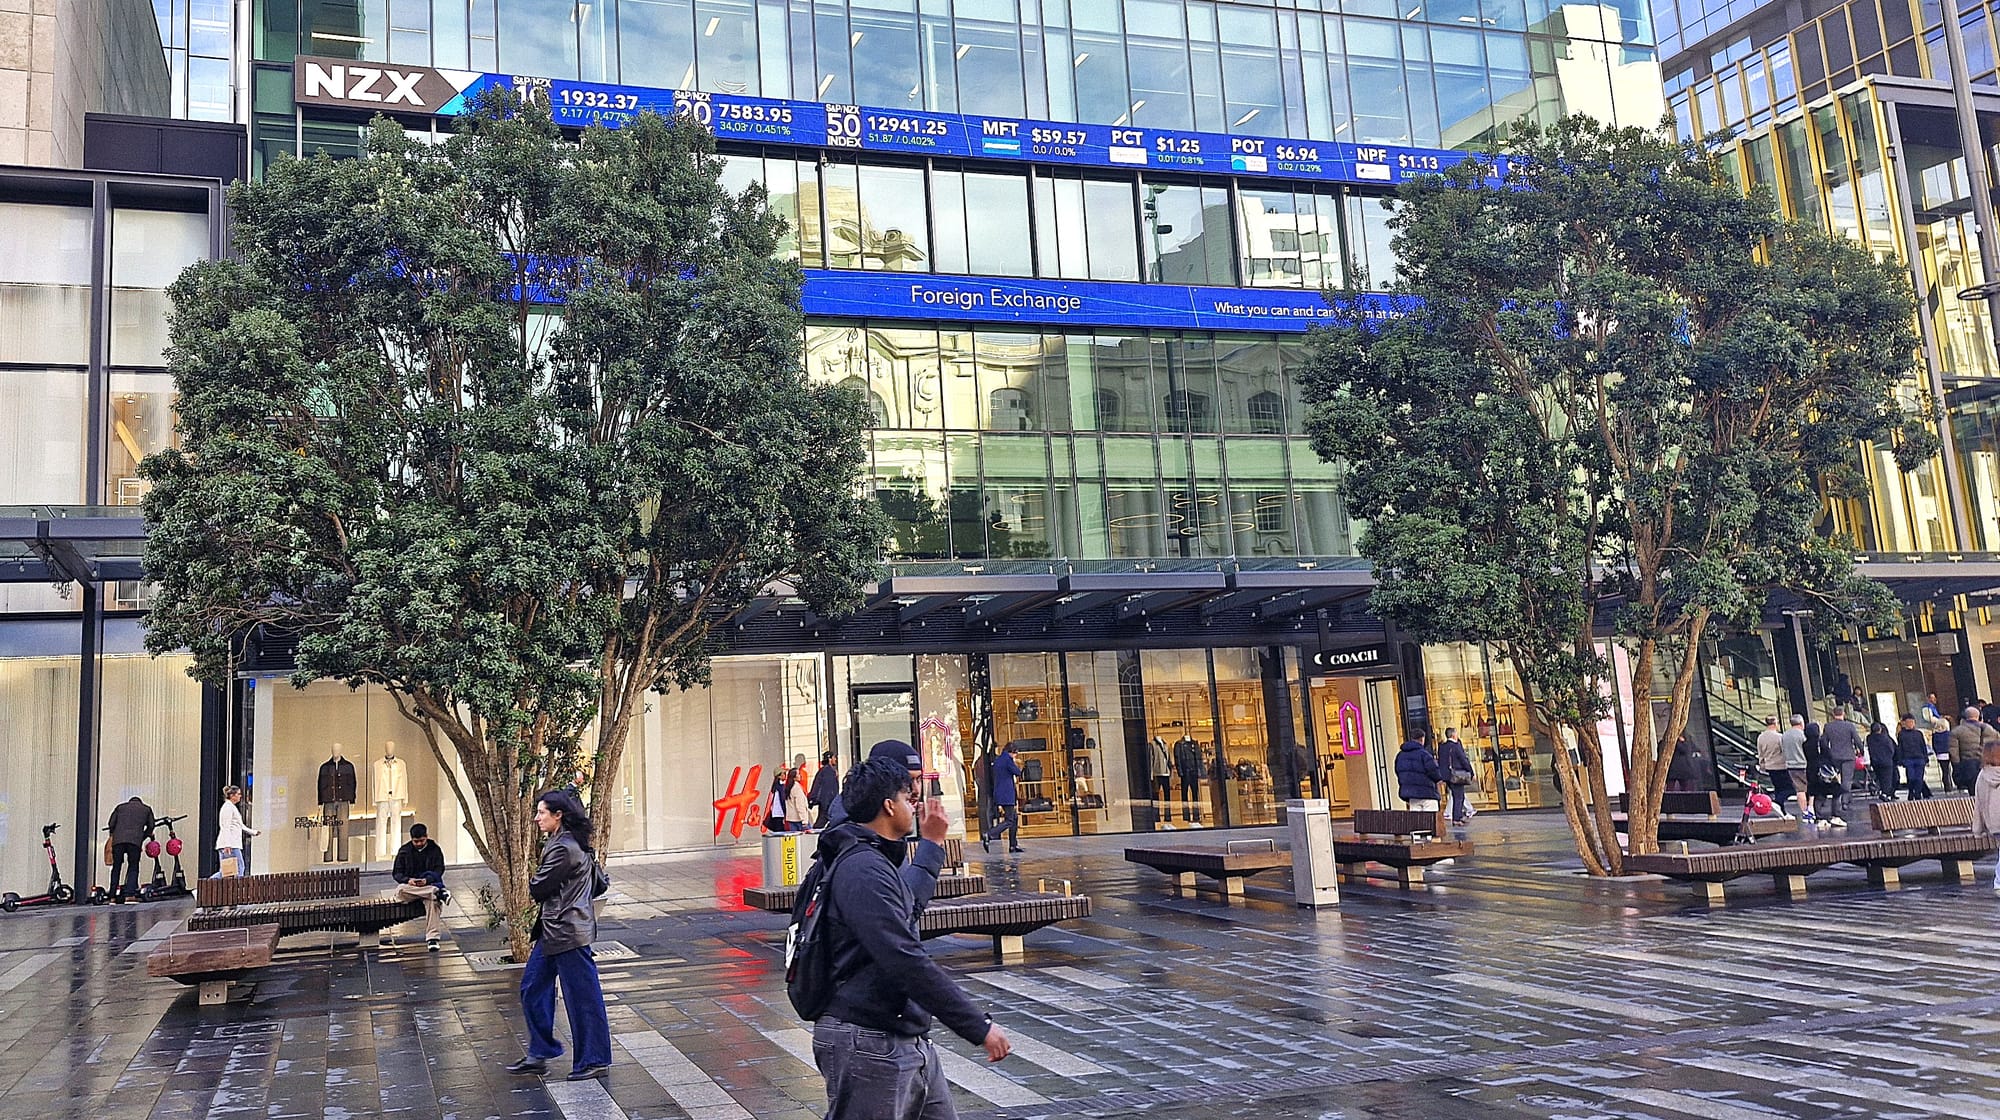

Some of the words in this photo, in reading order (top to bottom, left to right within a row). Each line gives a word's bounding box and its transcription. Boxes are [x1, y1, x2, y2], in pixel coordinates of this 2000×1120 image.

[305, 62, 426, 106] NZX
[560, 89, 638, 110] 1932.37
[561, 107, 583, 118] 9.17
[594, 110, 631, 122] 0.477%
[675, 99, 712, 125] 20
[719, 103, 792, 123] 7583.95
[756, 124, 791, 136] 0.451%
[827, 112, 861, 138] 50
[868, 116, 948, 136] 12941.25
[982, 120, 1020, 137] MFT
[827, 135, 863, 148] INDEX
[869, 132, 893, 143] 51.87
[902, 135, 936, 147] 0.402%
[1032, 127, 1087, 145] $59.57
[1111, 130, 1144, 146] PCT
[1157, 136, 1200, 153] $1.25
[1033, 144, 1047, 155] 0.0
[1055, 145, 1077, 157] 0.0%
[1231, 138, 1265, 154] POT
[1276, 145, 1318, 162] $6.94
[1159, 154, 1174, 163] 0.01
[1181, 155, 1204, 165] 0.81%
[1356, 147, 1387, 163] NPF
[1399, 153, 1439, 170] $1.13
[1278, 162, 1293, 171] 0.02
[1300, 163, 1322, 173] 0.29%
[911, 285, 985, 311] Foreign
[991, 288, 1081, 314] Exchange
[1214, 301, 1245, 315] What
[1247, 305, 1268, 318] you
[1270, 306, 1290, 317] can
[1293, 305, 1314, 318] and
[1376, 305, 1387, 320] at
[1330, 650, 1378, 664] COACH
[713, 765, 774, 838] H&
[785, 847, 795, 886] ecycling
